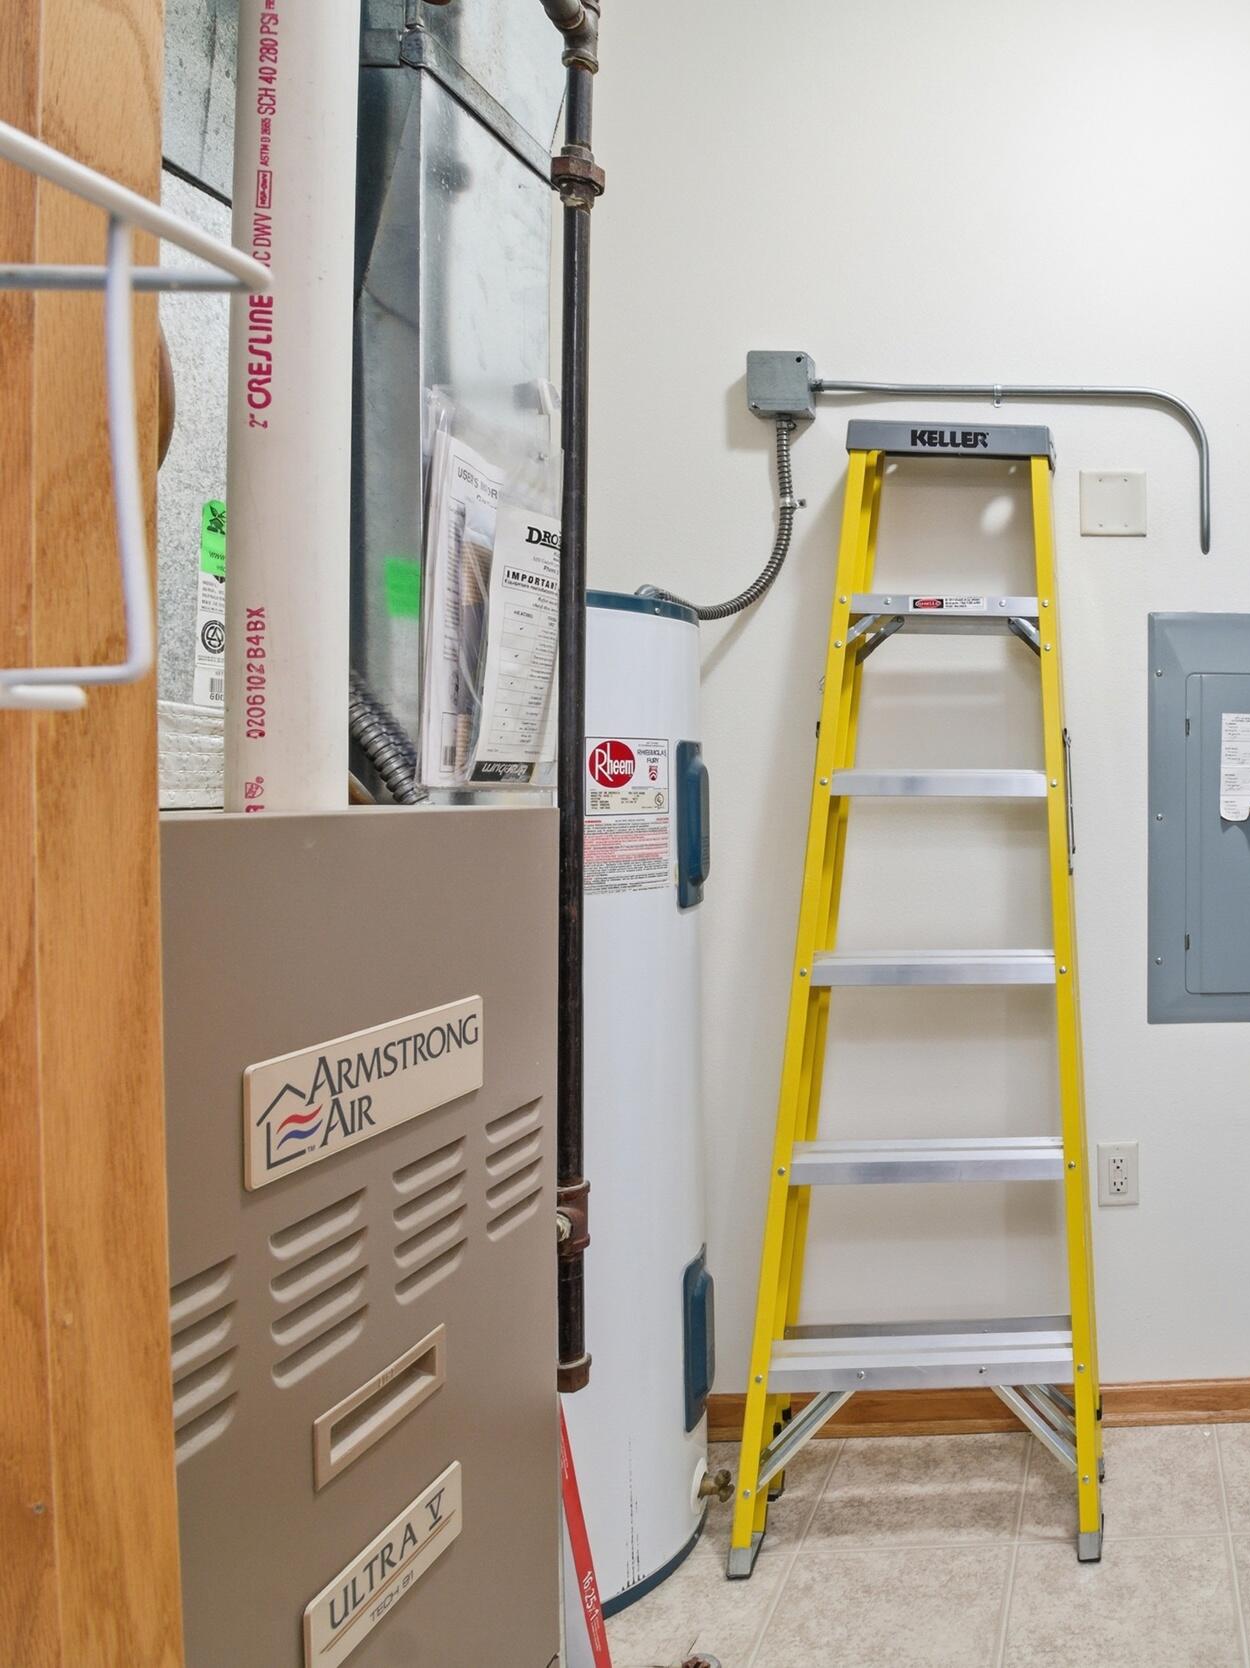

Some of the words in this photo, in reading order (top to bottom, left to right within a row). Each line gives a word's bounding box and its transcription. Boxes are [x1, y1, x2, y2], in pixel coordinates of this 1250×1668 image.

[259, 12, 279, 36] PSI
[258, 37, 279, 64] 280
[258, 66, 278, 85] 40
[257, 87, 277, 116] SCH
[259, 143, 271, 167] ASTM
[252, 212, 272, 248] DWV
[247, 294, 274, 410] CRESLINE
[910, 429, 989, 449] KELLER
[525, 525, 562, 547] DRO
[595, 742, 634, 782] Rheem
[305, 1013, 479, 1107] ARMSTRONG
[319, 1094, 376, 1149] AIR
[328, 1521, 419, 1631] ULTRA
[425, 1486, 446, 1532] V
